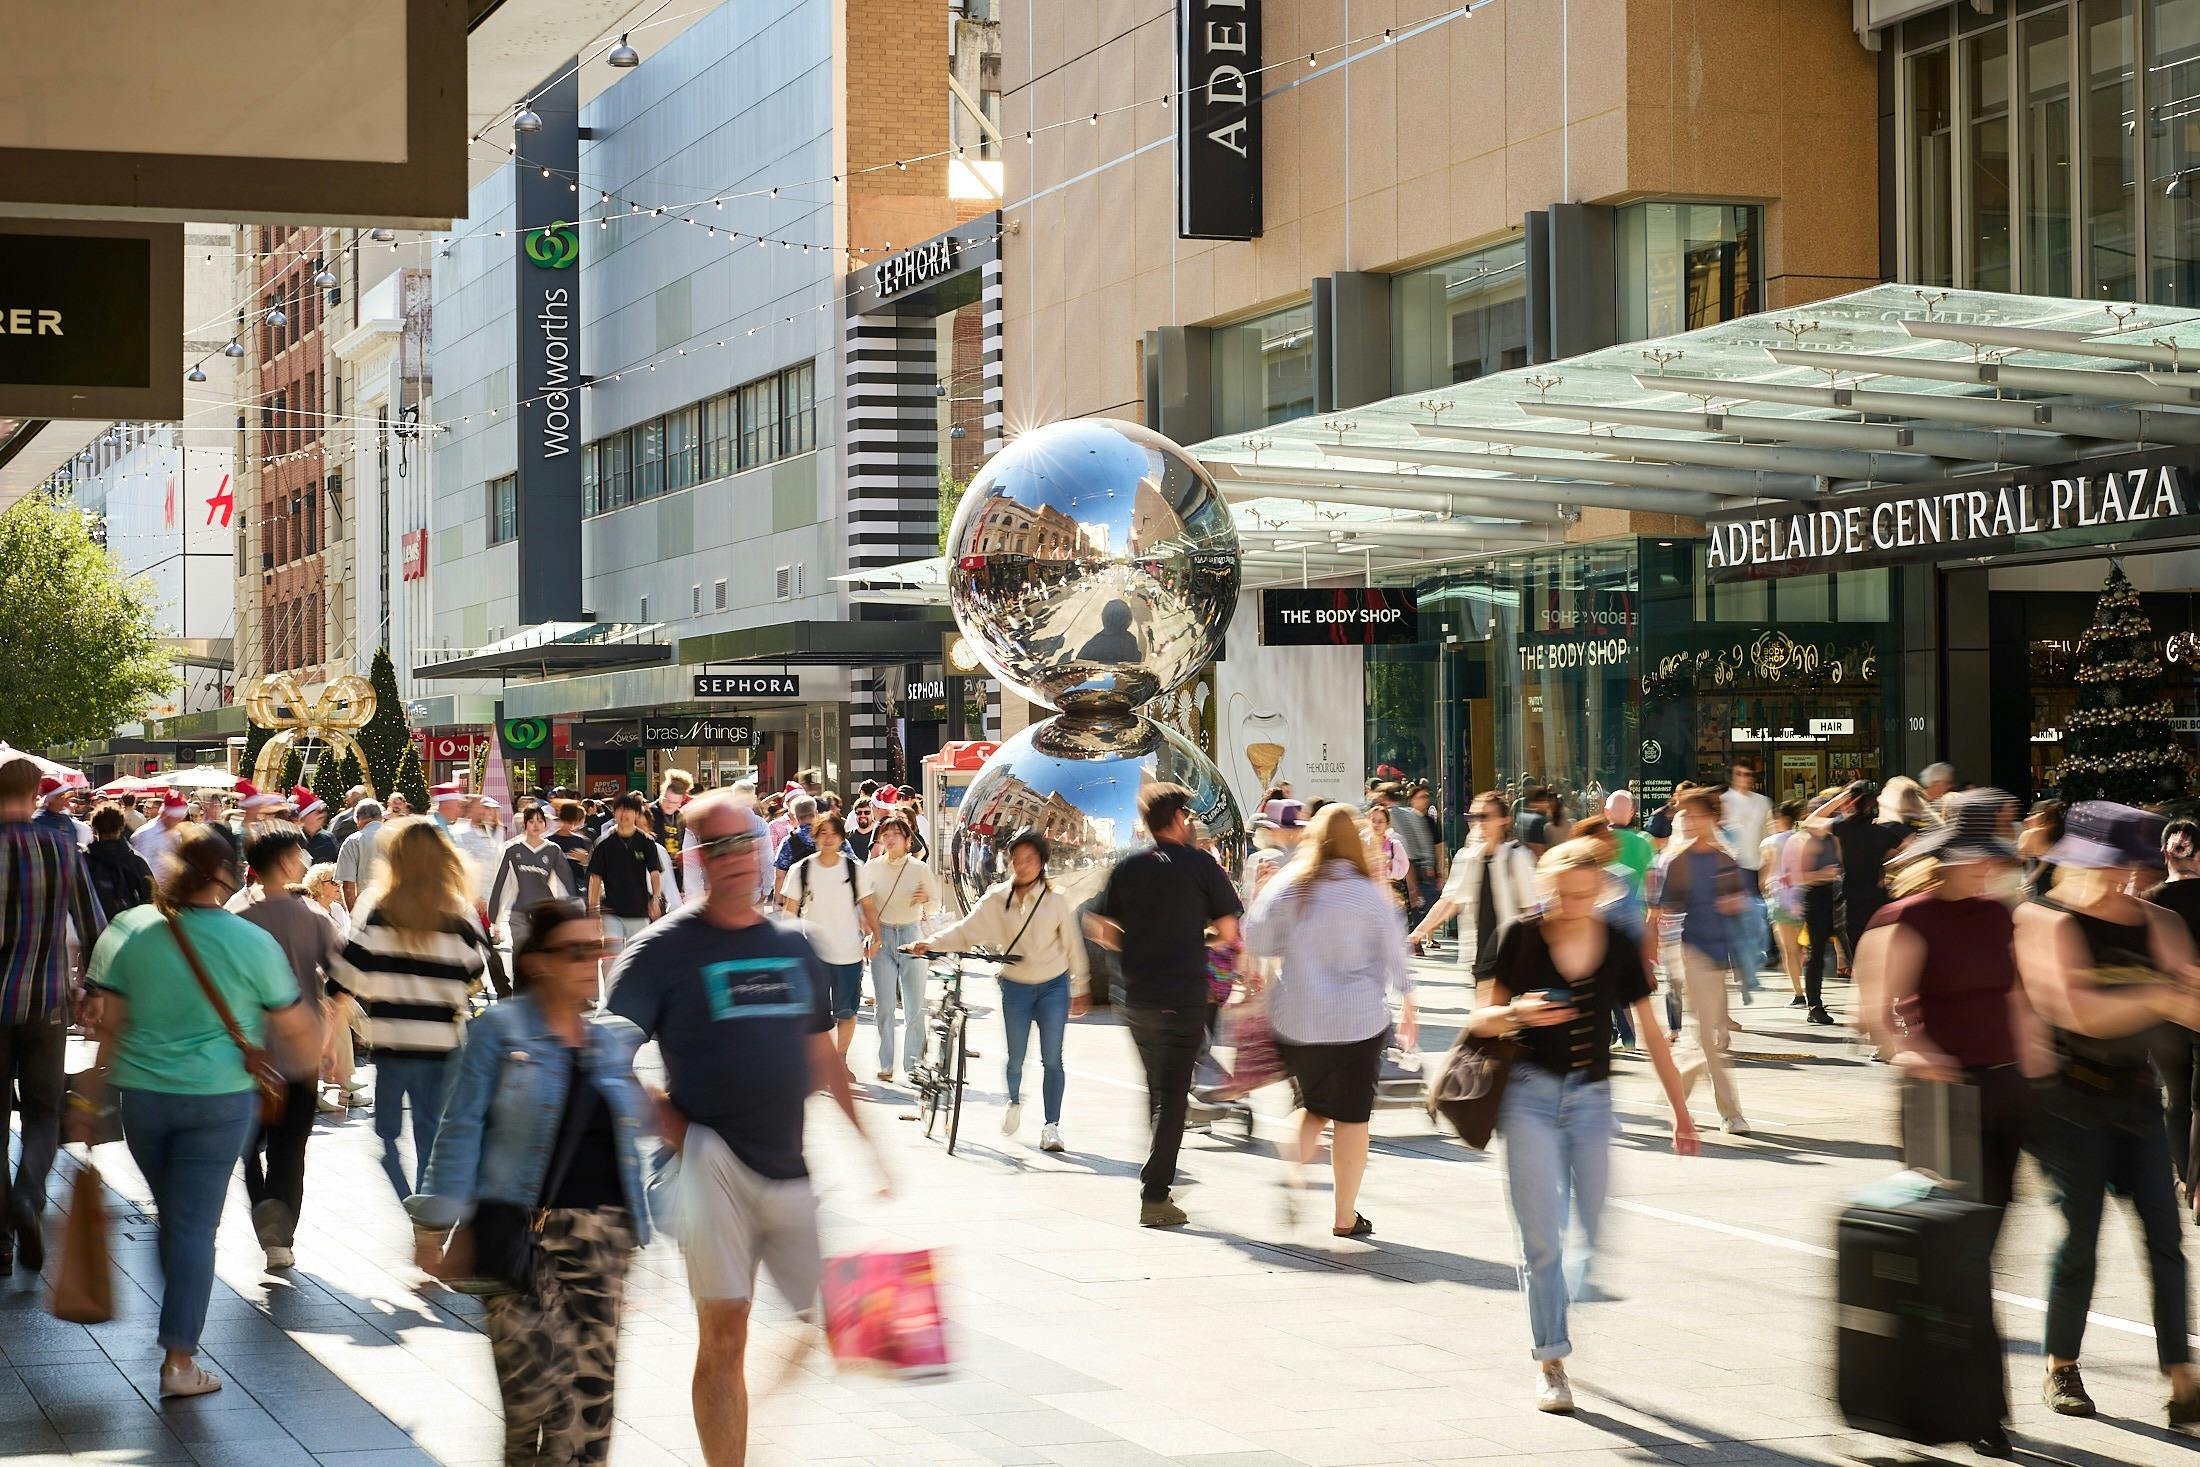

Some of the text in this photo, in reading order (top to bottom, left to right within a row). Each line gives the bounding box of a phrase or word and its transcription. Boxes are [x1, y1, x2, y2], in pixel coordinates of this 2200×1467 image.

[875, 236, 951, 298] SEPHORA
[0, 308, 64, 336] ER
[537, 288, 570, 458] Woolworths
[1707, 465, 2180, 569] ADELAIDE CENTRAL PLAZA
[1280, 608, 1401, 624] THE BODY SHOP
[1519, 638, 1628, 671] THE BODY SHOP
[1763, 647, 1785, 655] BODY
[699, 679, 795, 693] SEPHORA
[907, 680, 945, 700] SEPHORA
[1820, 722, 1842, 732] HAIR
[1909, 716, 1925, 731] 100
[2168, 719, 2188, 730] OUR
[646, 724, 679, 740] bras
[704, 724, 748, 743] things
[1305, 762, 1314, 773] THE
[1330, 762, 1345, 773] GLASS
